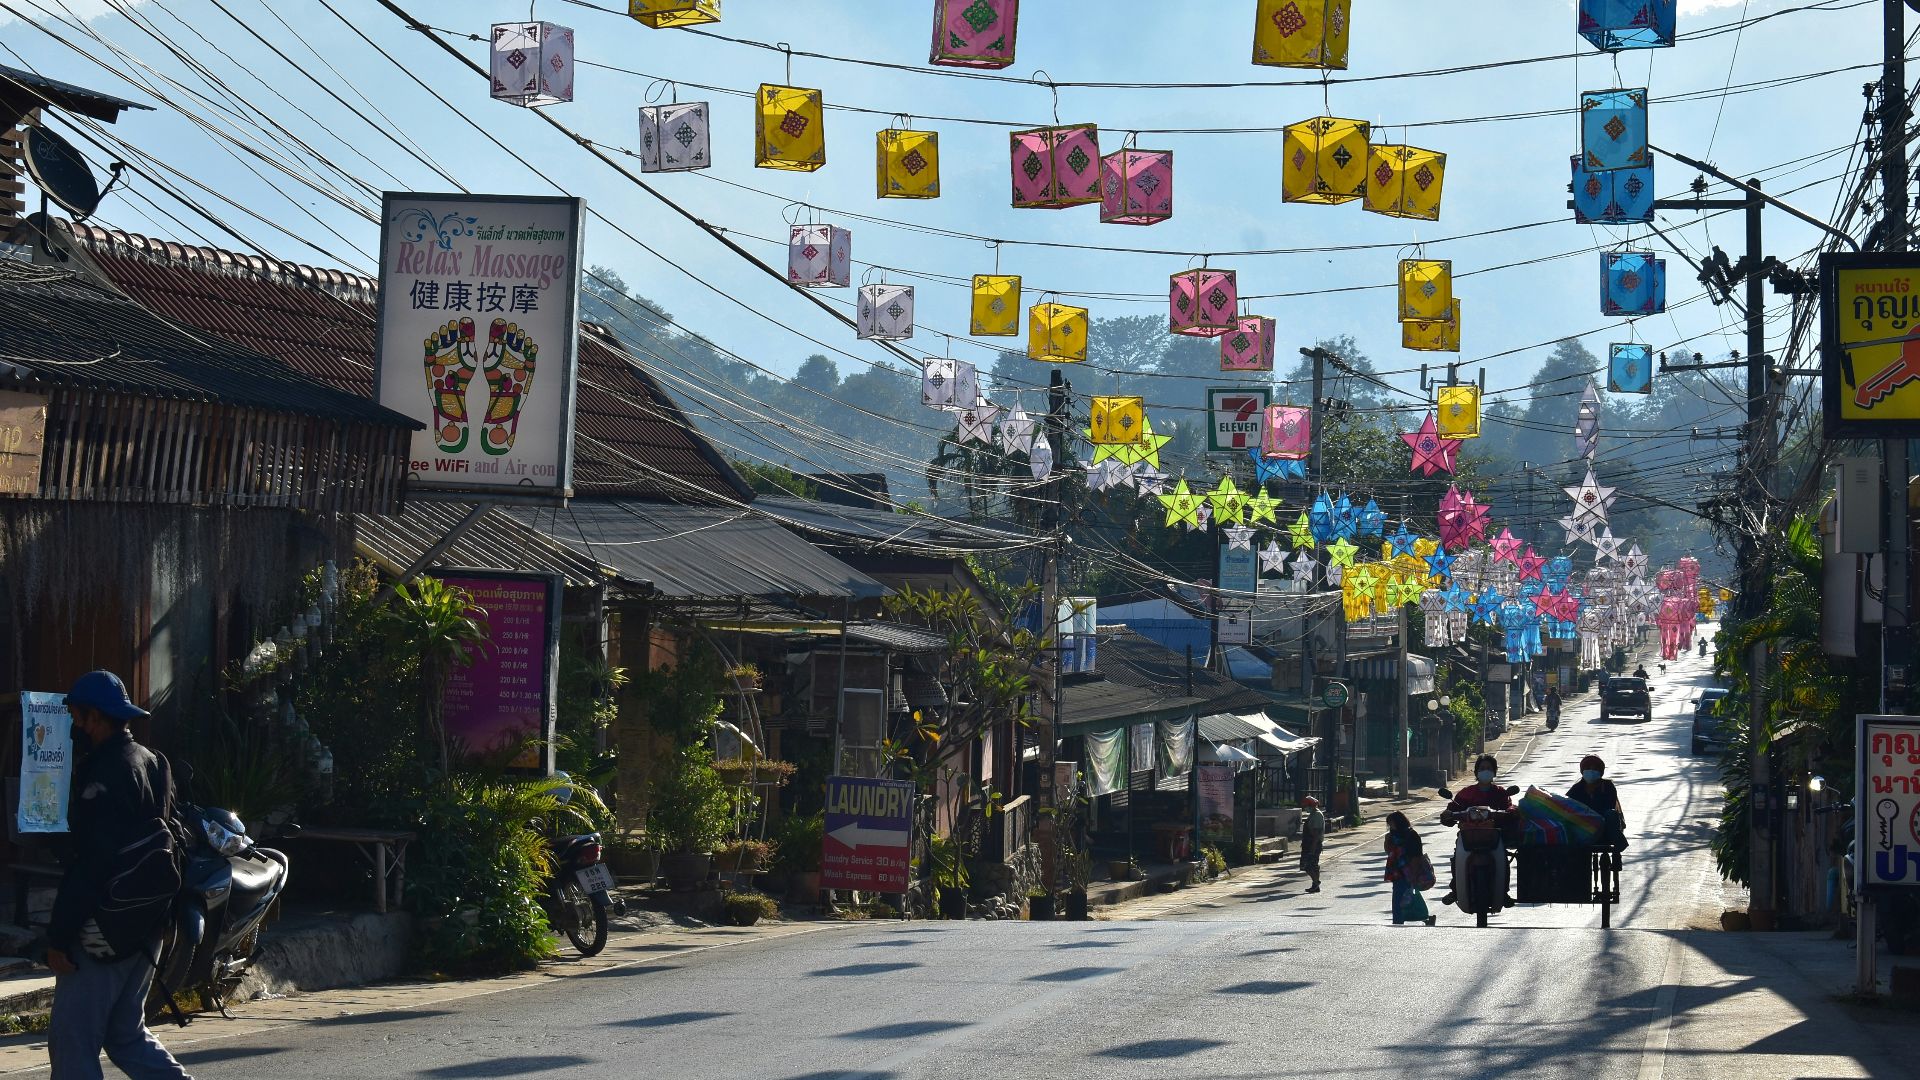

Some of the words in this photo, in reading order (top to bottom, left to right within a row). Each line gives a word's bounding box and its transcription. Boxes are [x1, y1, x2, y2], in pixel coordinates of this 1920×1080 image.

[507, 222, 566, 245] นวดเพื่อสุขภาพ
[395, 240, 463, 276] Relax
[469, 244, 565, 290] Massage
[409, 279, 540, 314] 健康按摩
[1222, 397, 1258, 448] 7
[435, 457, 469, 474] WiFi
[475, 459, 499, 475] and
[505, 459, 527, 476] Air
[532, 463, 556, 477] con
[828, 783, 911, 818] LAUNDRY
[824, 853, 849, 865] Laundry
[851, 855, 873, 865] Service
[876, 856, 889, 866] 30
